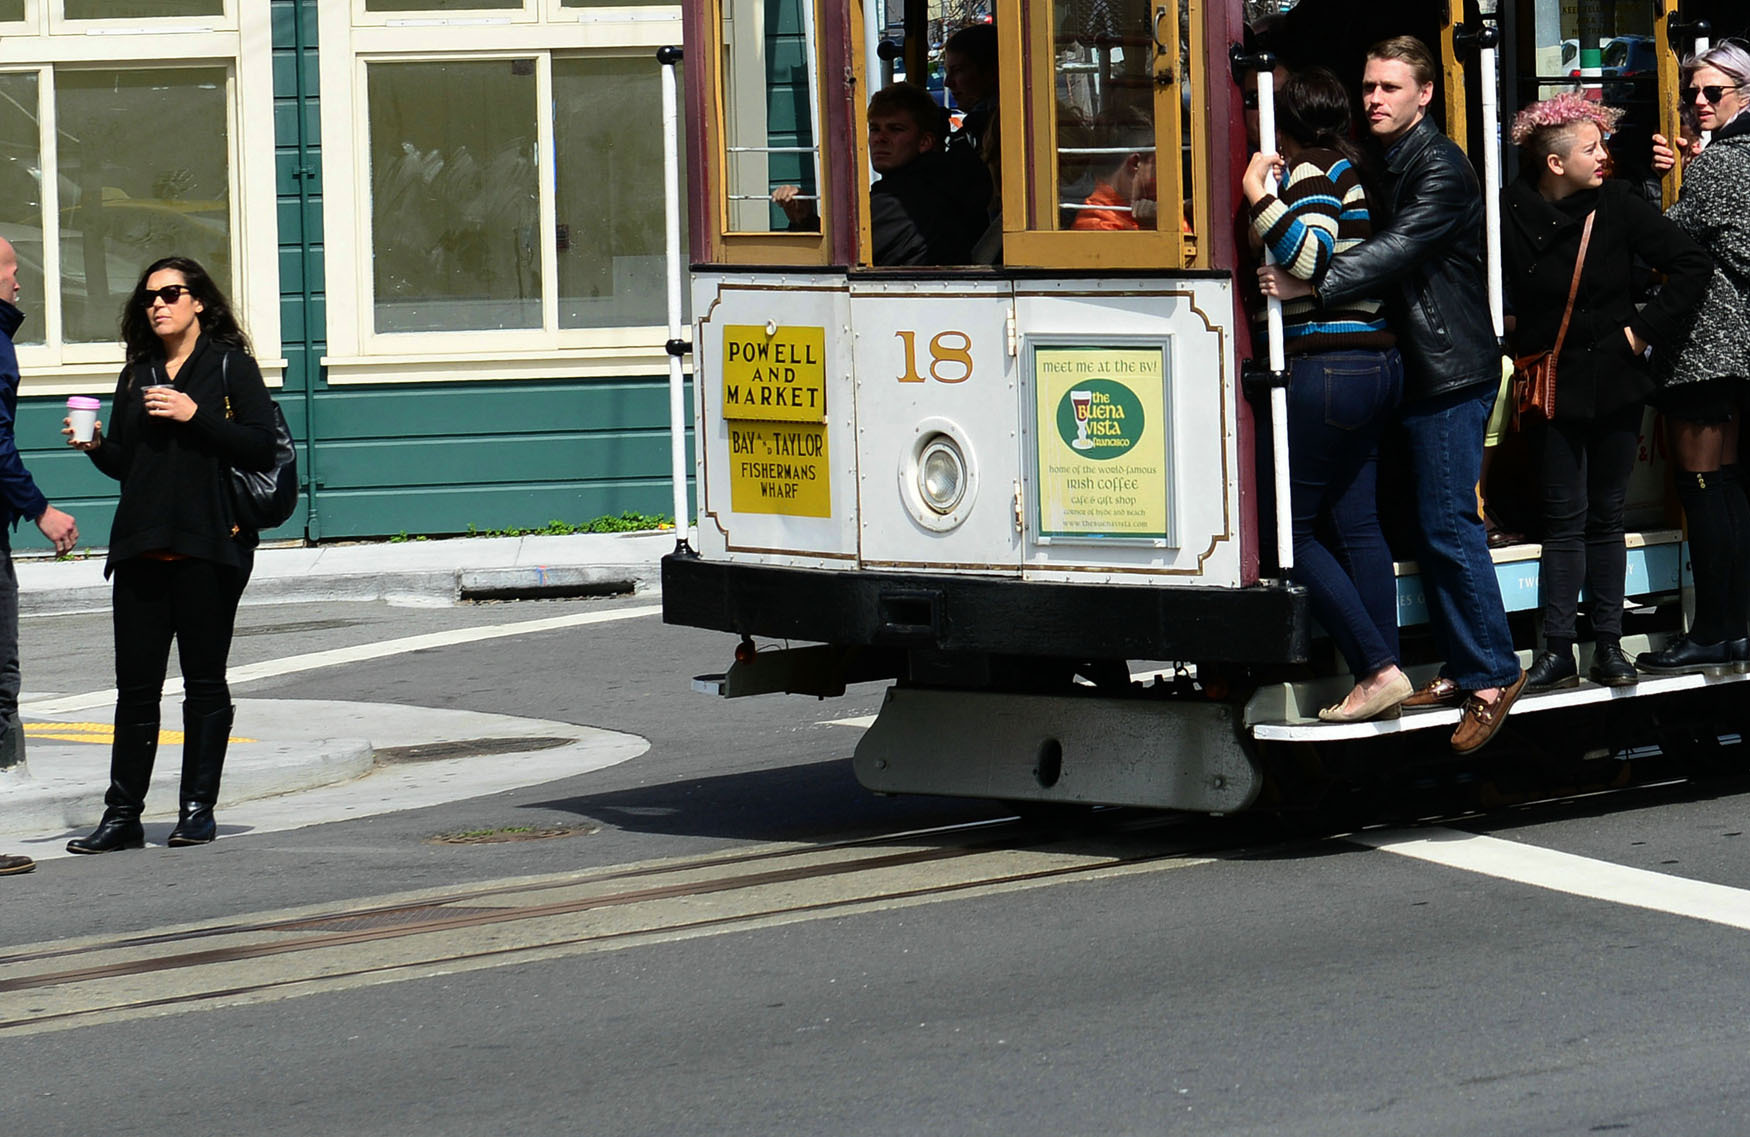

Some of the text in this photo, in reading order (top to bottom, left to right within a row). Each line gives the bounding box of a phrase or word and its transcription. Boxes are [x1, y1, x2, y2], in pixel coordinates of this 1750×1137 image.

[728, 341, 817, 364] POWELL
[895, 330, 973, 384] 18
[752, 367, 796, 383] AND
[1076, 361, 1094, 373] me
[1097, 360, 1111, 373] at
[1115, 359, 1136, 373] the
[727, 386, 819, 408] MARKET
[1092, 392, 1110, 404] the
[733, 431, 755, 454] BAY
[775, 432, 823, 457] TAYLOR
[741, 462, 816, 481] FISHERMANS
[761, 483, 799, 499] WHARF
